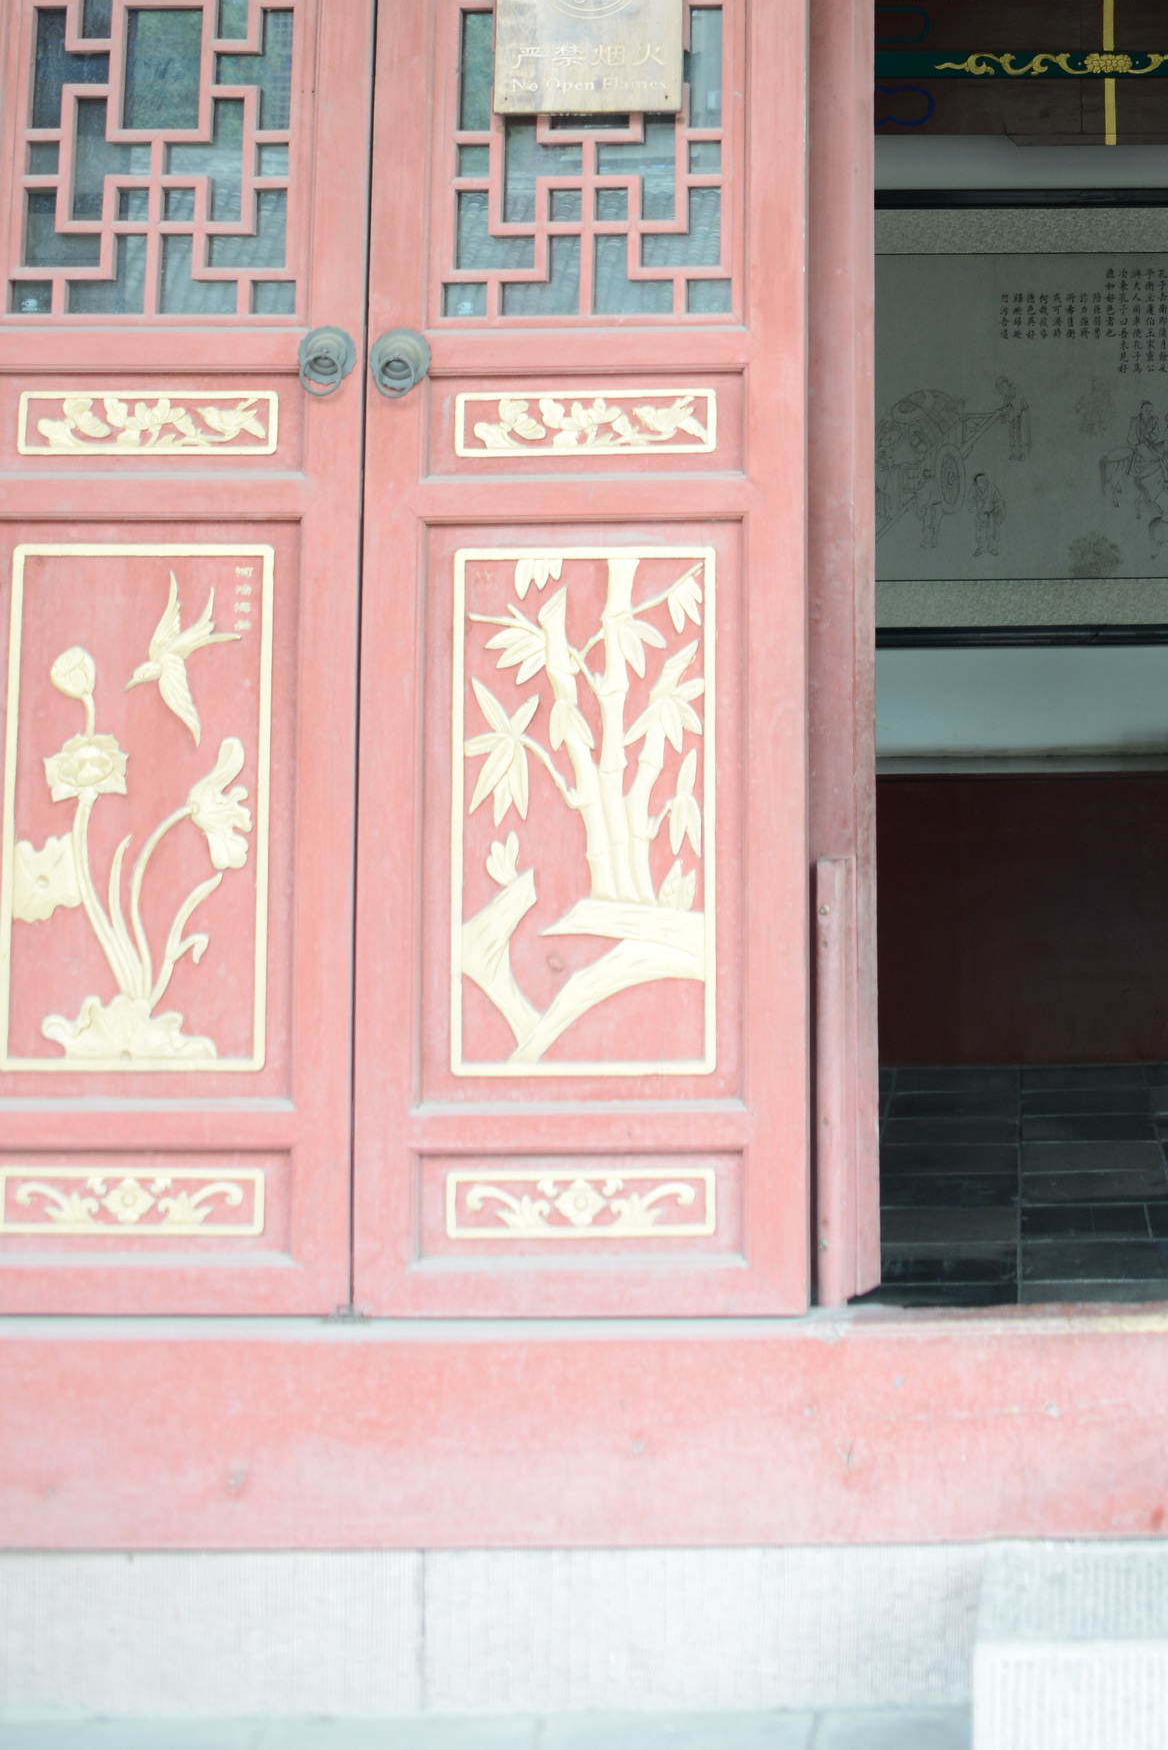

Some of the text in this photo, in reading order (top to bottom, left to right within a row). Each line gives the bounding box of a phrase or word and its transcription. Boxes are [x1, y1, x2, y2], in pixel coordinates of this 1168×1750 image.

[512, 43, 667, 69] 严禁烟火
[511, 77, 667, 94] No Open Flames
